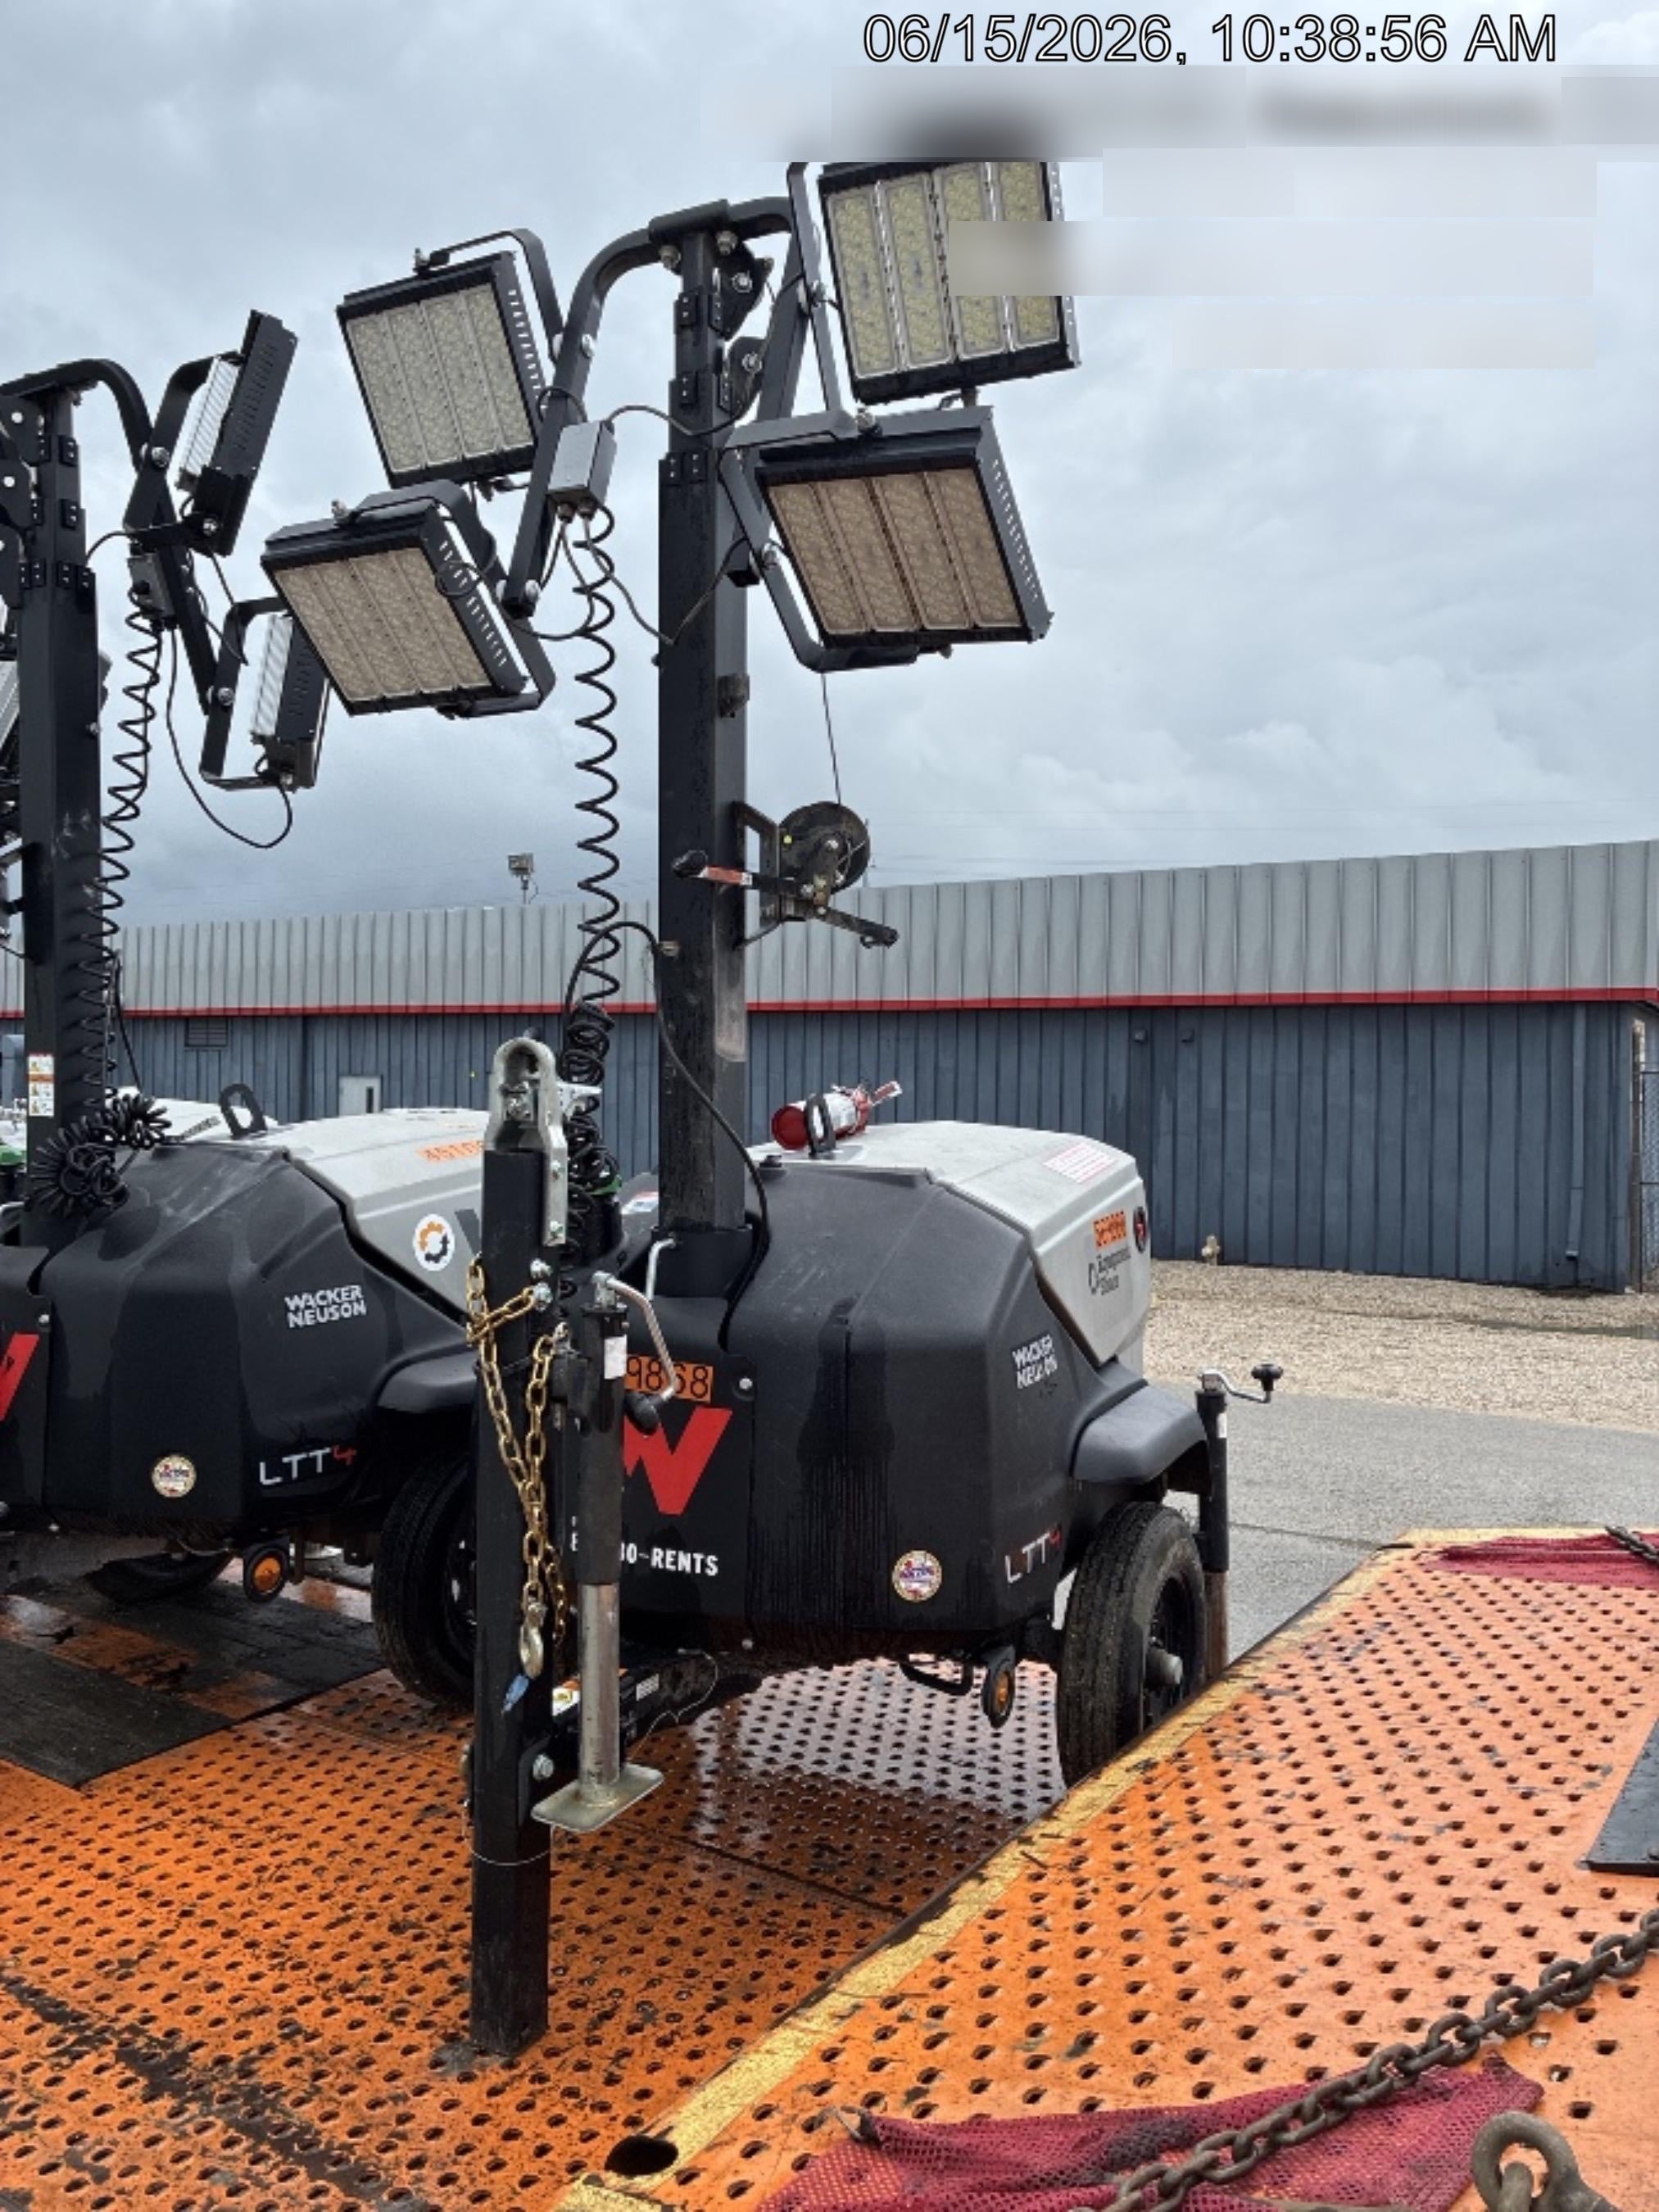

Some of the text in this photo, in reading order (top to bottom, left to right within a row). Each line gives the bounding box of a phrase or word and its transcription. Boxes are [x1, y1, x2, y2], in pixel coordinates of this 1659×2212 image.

[283, 1284, 364, 1312] WACKER
[288, 1299, 367, 1329] NEUSON
[259, 1444, 356, 1485] LTT4
